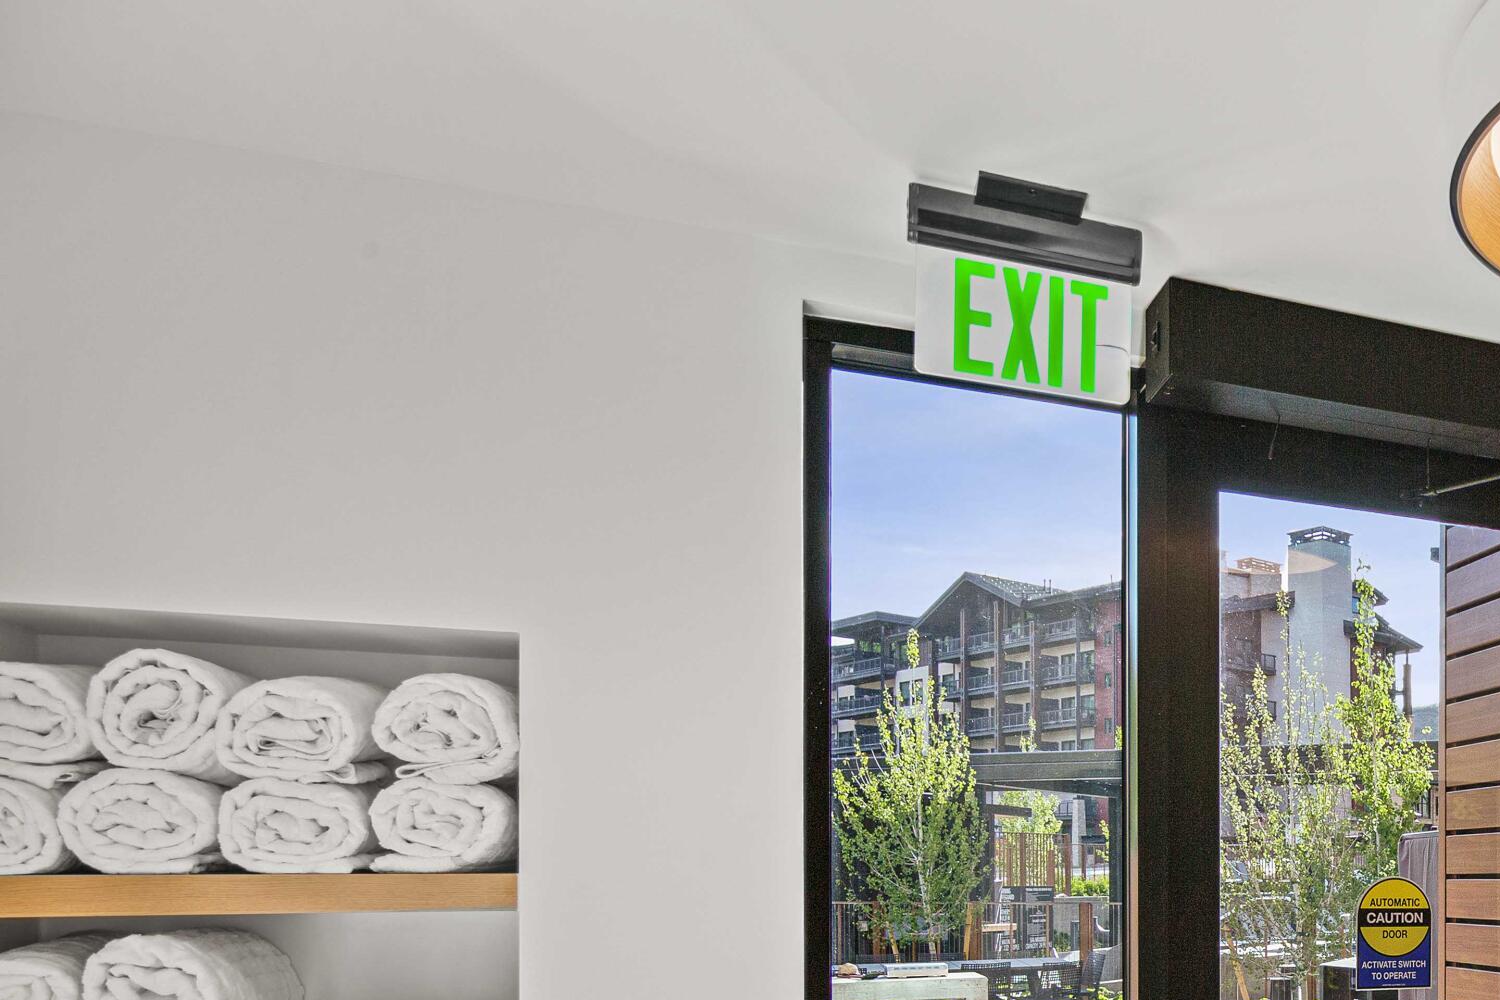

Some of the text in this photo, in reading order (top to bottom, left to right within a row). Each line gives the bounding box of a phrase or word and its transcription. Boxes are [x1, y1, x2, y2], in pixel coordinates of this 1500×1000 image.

[953, 258, 1109, 393] EXIT
[1369, 897, 1421, 907] AUTOMATIC
[1366, 912, 1424, 924] CAUTION
[1382, 929, 1408, 939] DOOR
[1361, 960, 1426, 969] ACTIVATE SWITCH
[1371, 971, 1417, 980] TO OPERATE
